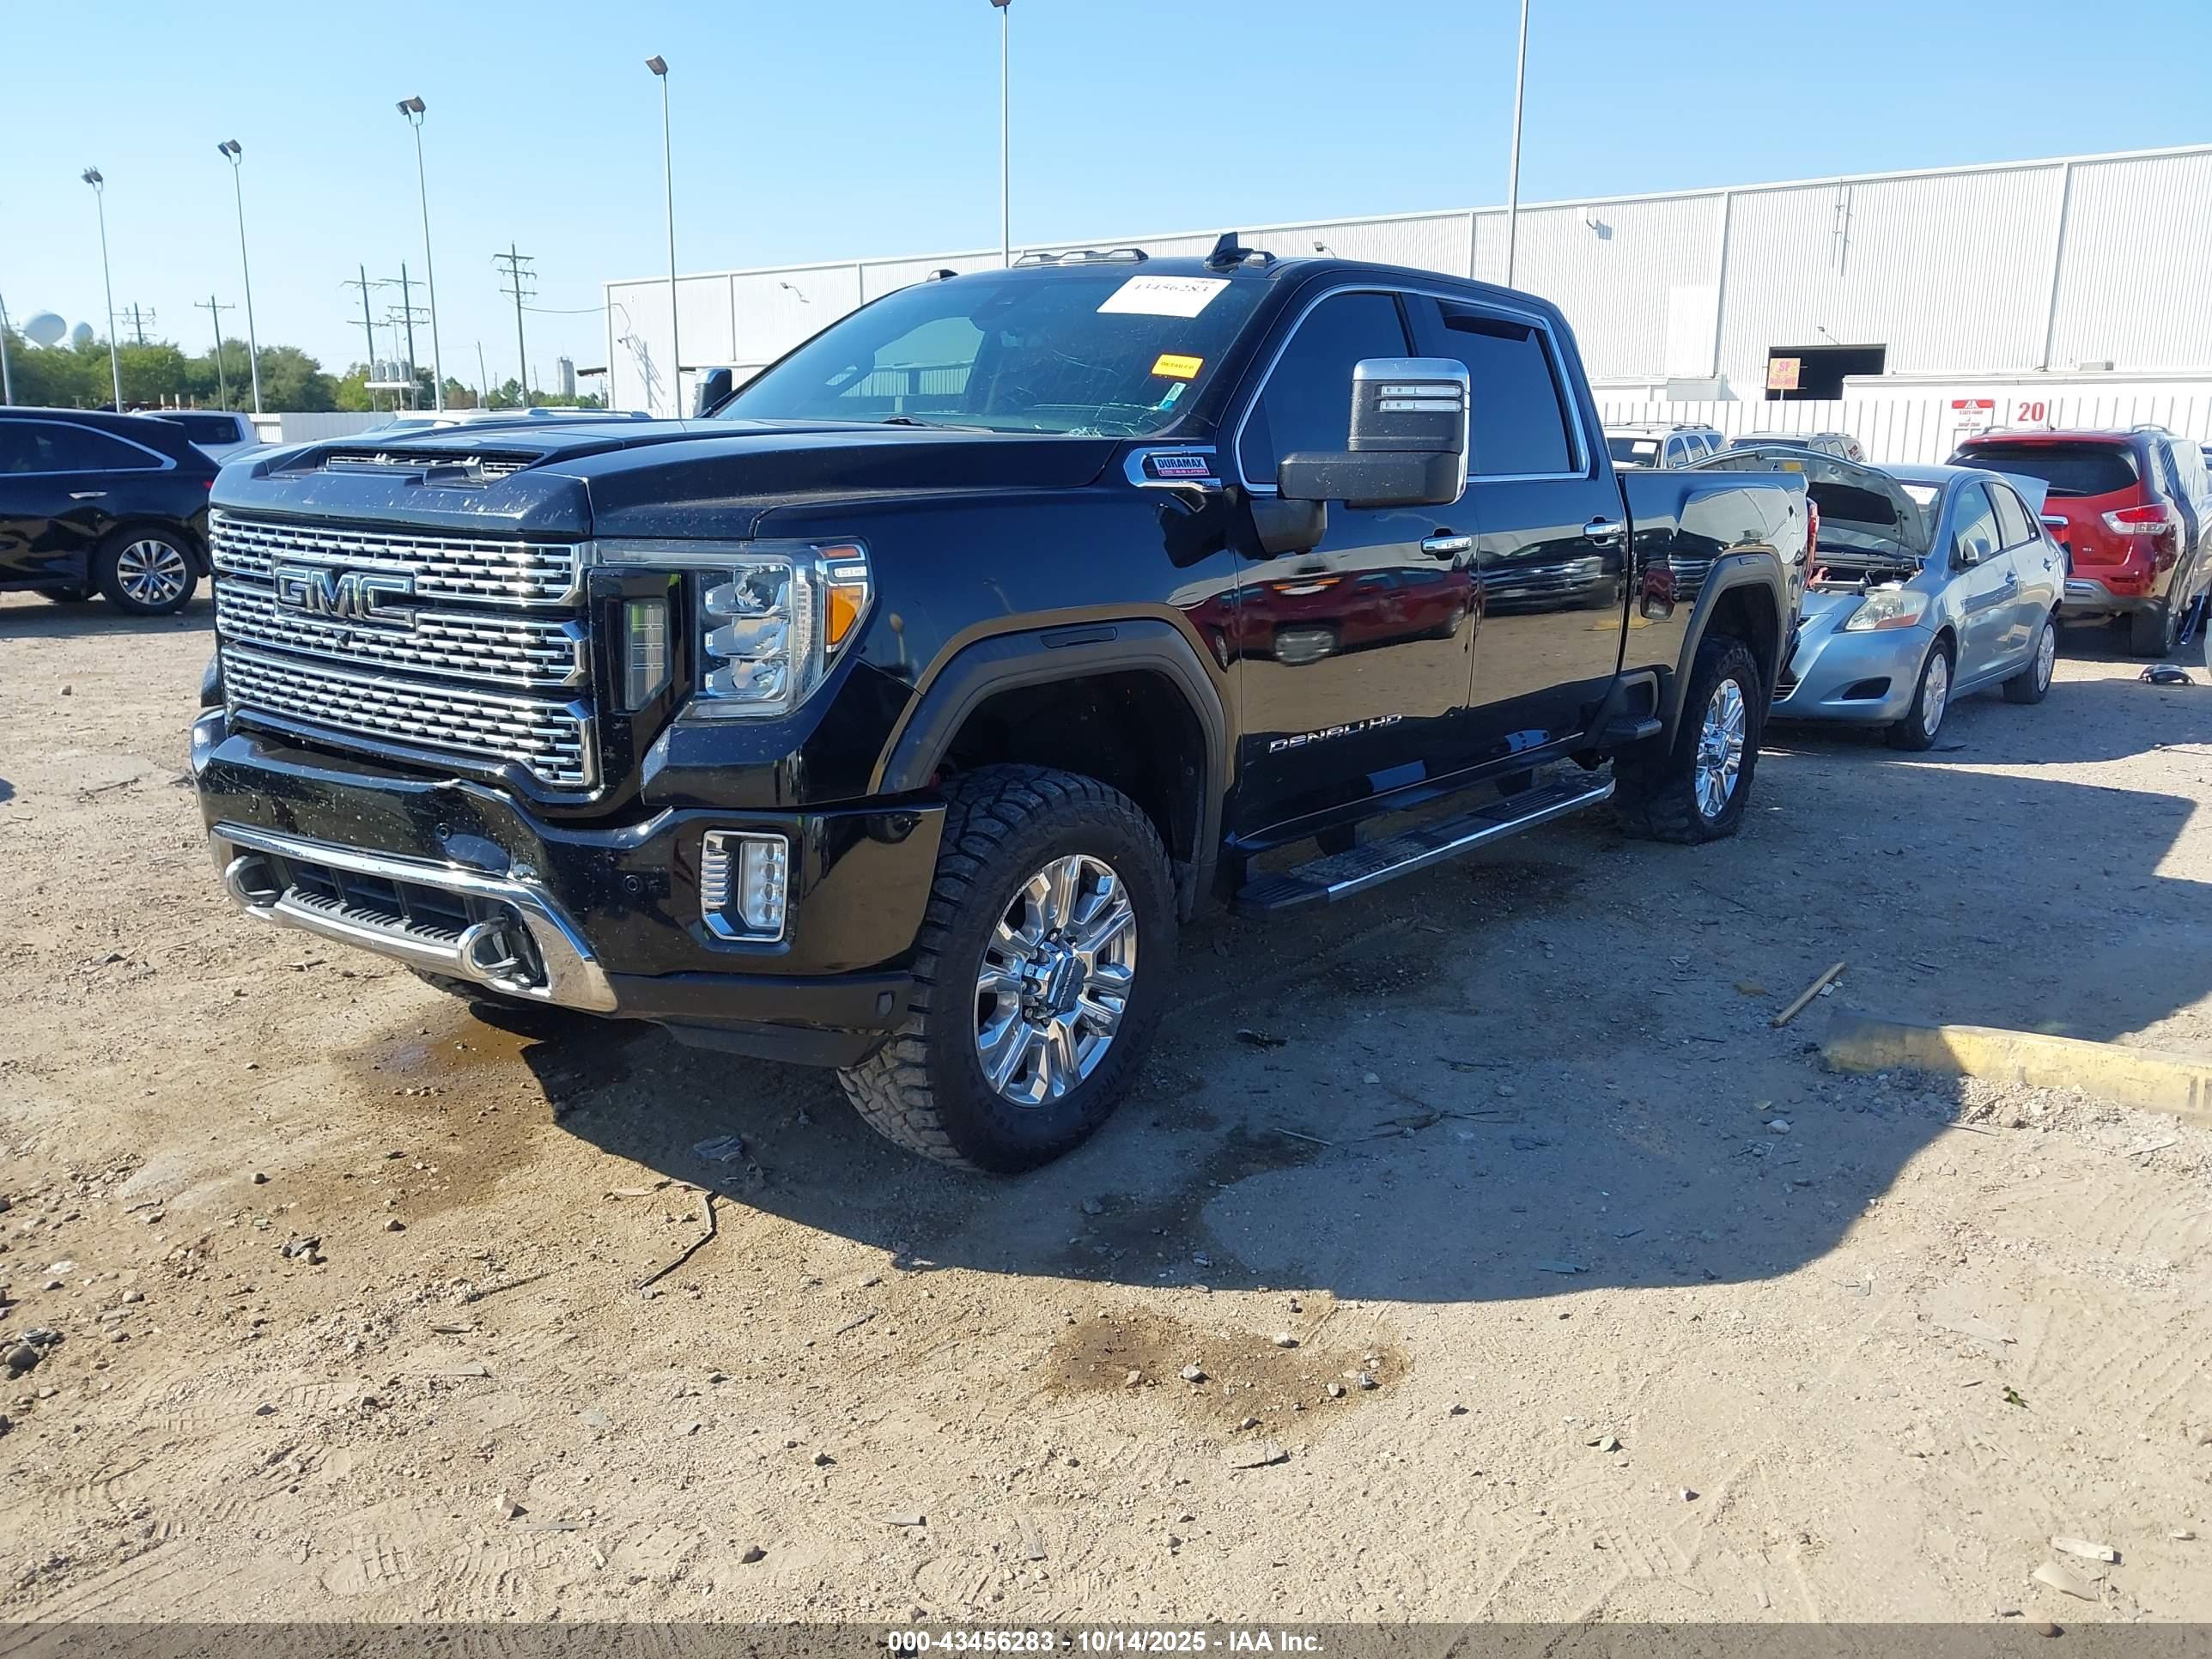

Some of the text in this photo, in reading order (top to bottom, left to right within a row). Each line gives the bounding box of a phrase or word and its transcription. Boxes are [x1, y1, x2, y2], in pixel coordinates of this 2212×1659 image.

[2018, 402, 2045, 422] 20
[1157, 458, 1205, 469] DURAMAX
[274, 567, 415, 628] GMC
[1268, 713, 1402, 754] DENALI HD
